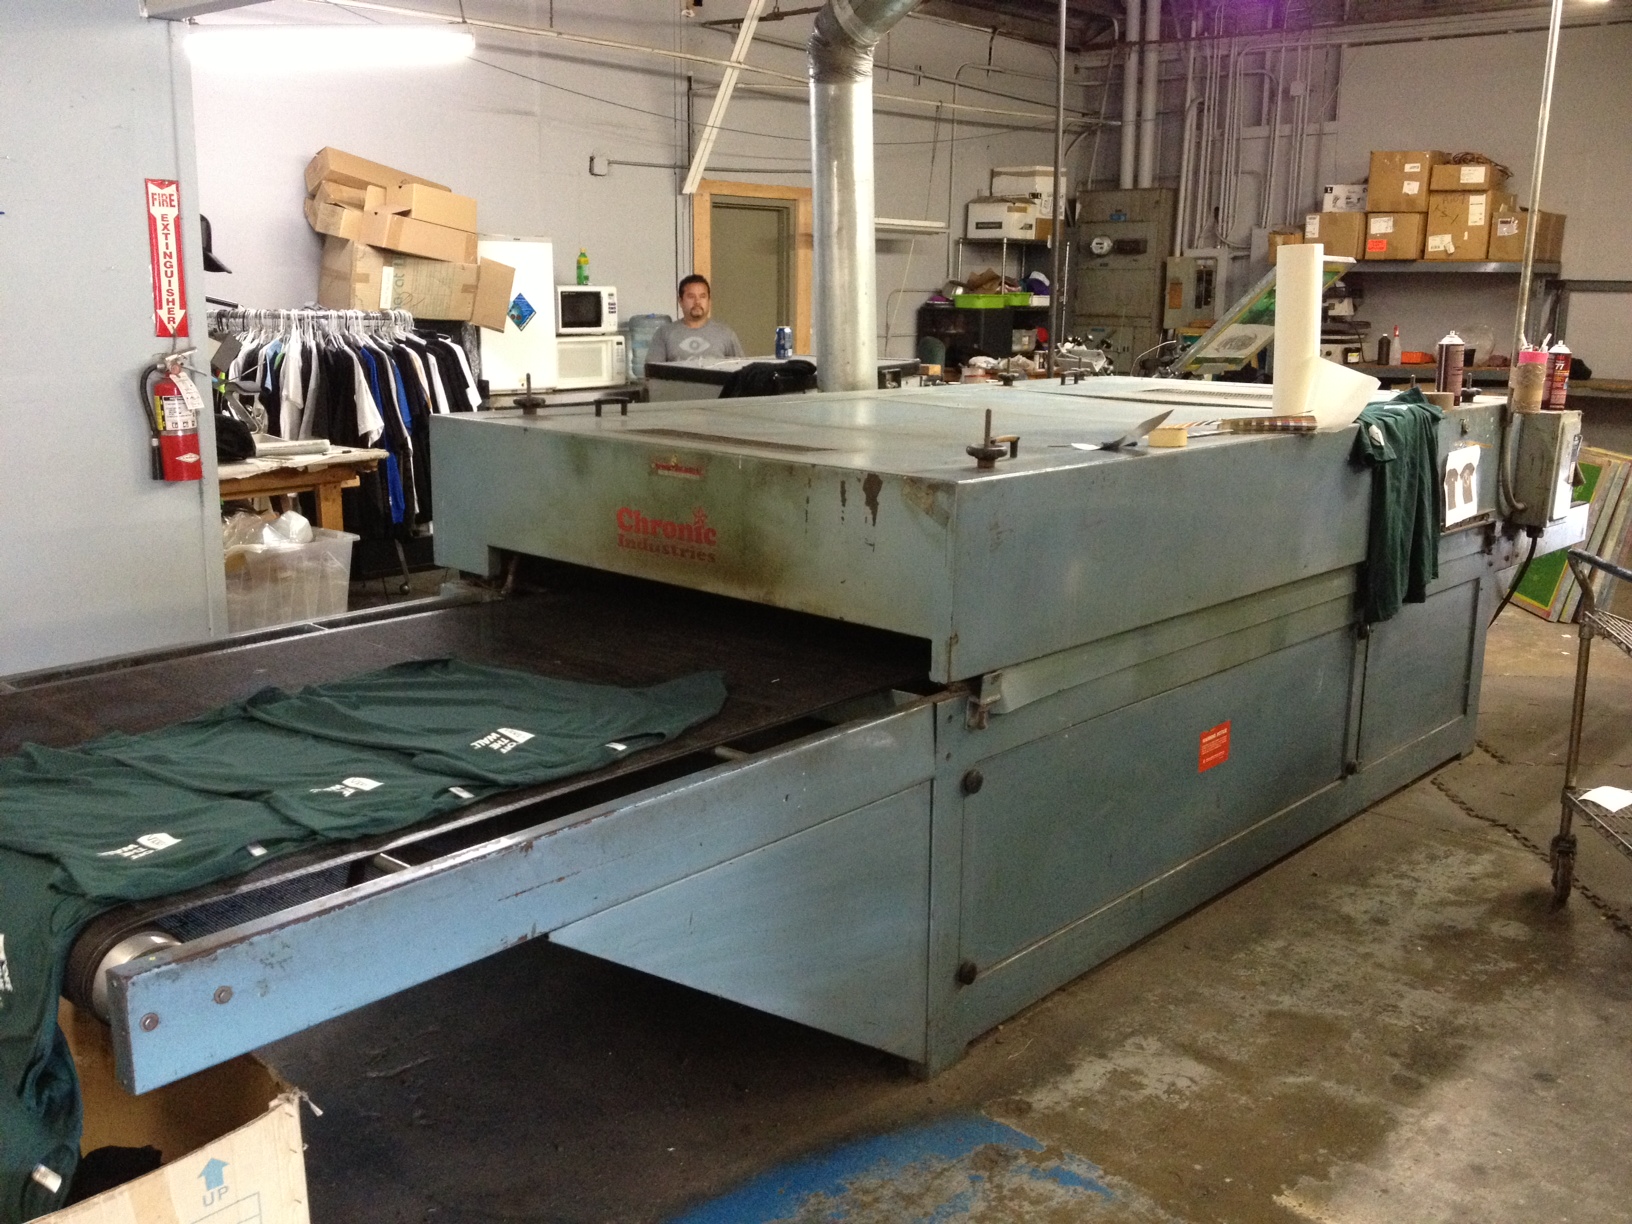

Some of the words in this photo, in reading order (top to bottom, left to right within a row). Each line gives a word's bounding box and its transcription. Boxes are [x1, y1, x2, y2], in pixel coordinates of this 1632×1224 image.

[151, 192, 176, 208] FIRE
[160, 213, 176, 325] EXTINGUISHER
[616, 507, 717, 546] Chronic
[617, 533, 717, 563] Industries
[202, 1185, 229, 1208] UP
